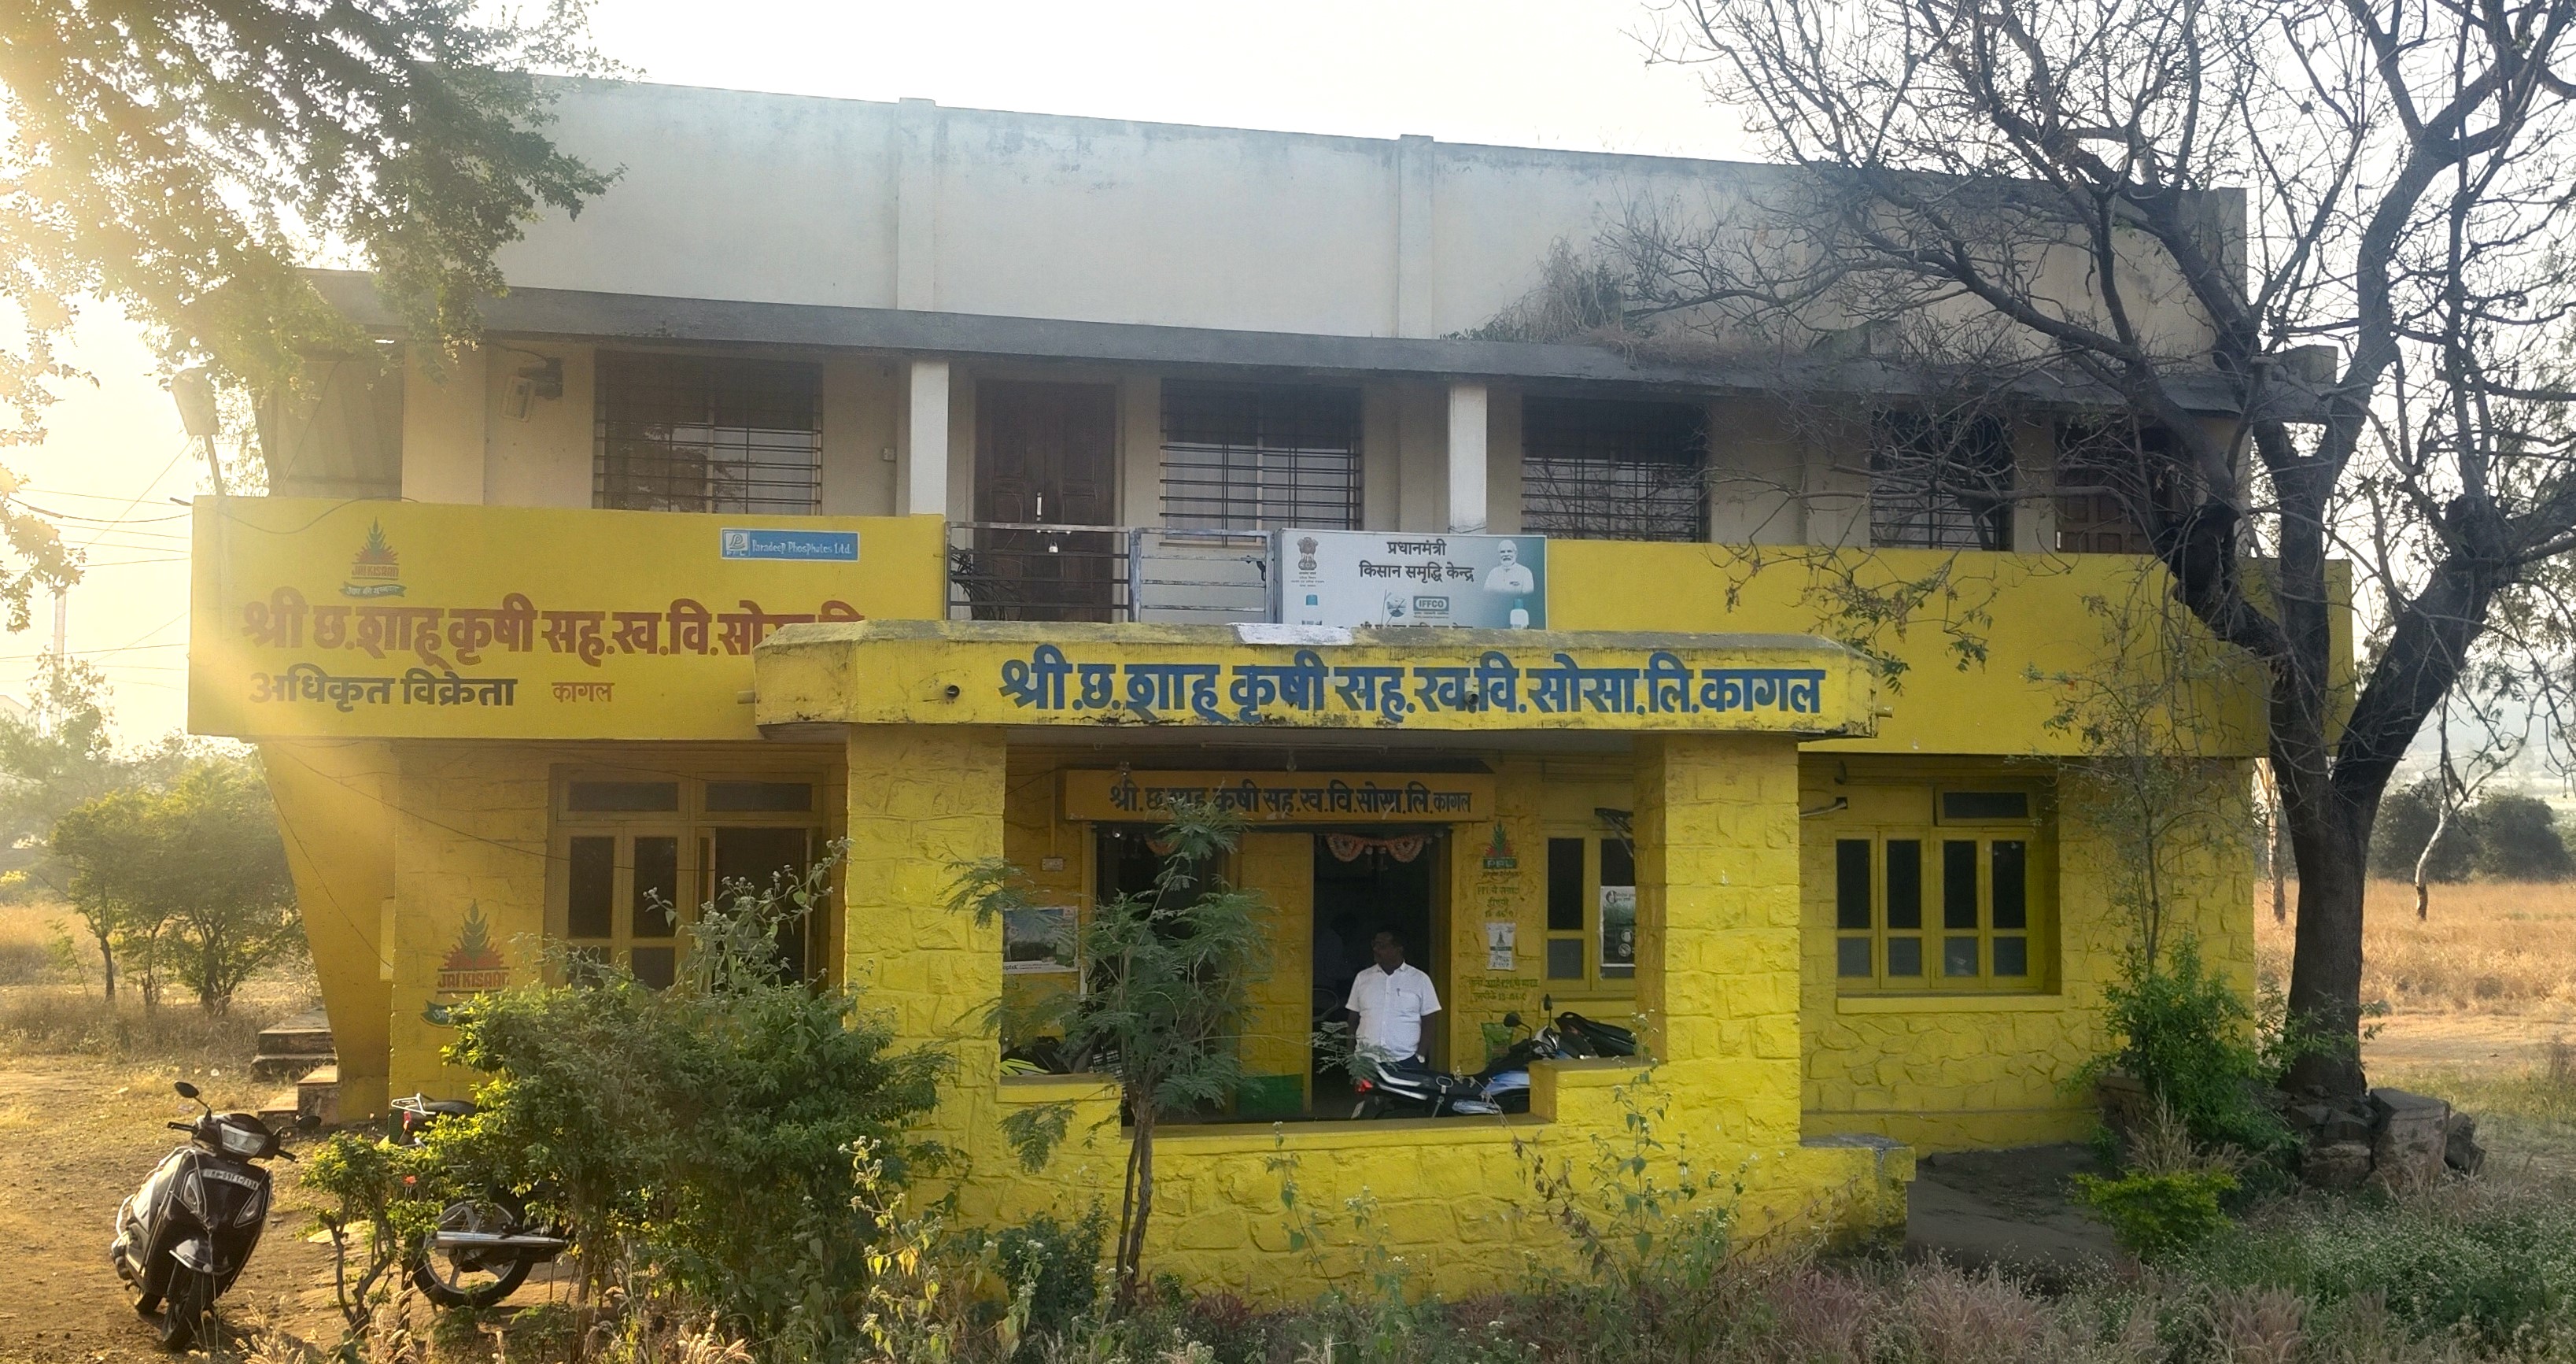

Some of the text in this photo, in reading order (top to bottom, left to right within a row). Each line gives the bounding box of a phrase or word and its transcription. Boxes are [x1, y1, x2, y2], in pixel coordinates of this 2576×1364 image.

[1387, 538, 1447, 556] प्रधानमंत्री
[1359, 560, 1474, 583] किसान समृद्धि केन्द्र
[1419, 599, 1444, 608] IFFCO
[242, 586, 308, 649] श्री
[448, 593, 538, 666] कृषी
[249, 663, 614, 712] अधिकृत विक्रेता कागल
[1230, 649, 1329, 723] कृषी
[438, 972, 459, 988] JAI
